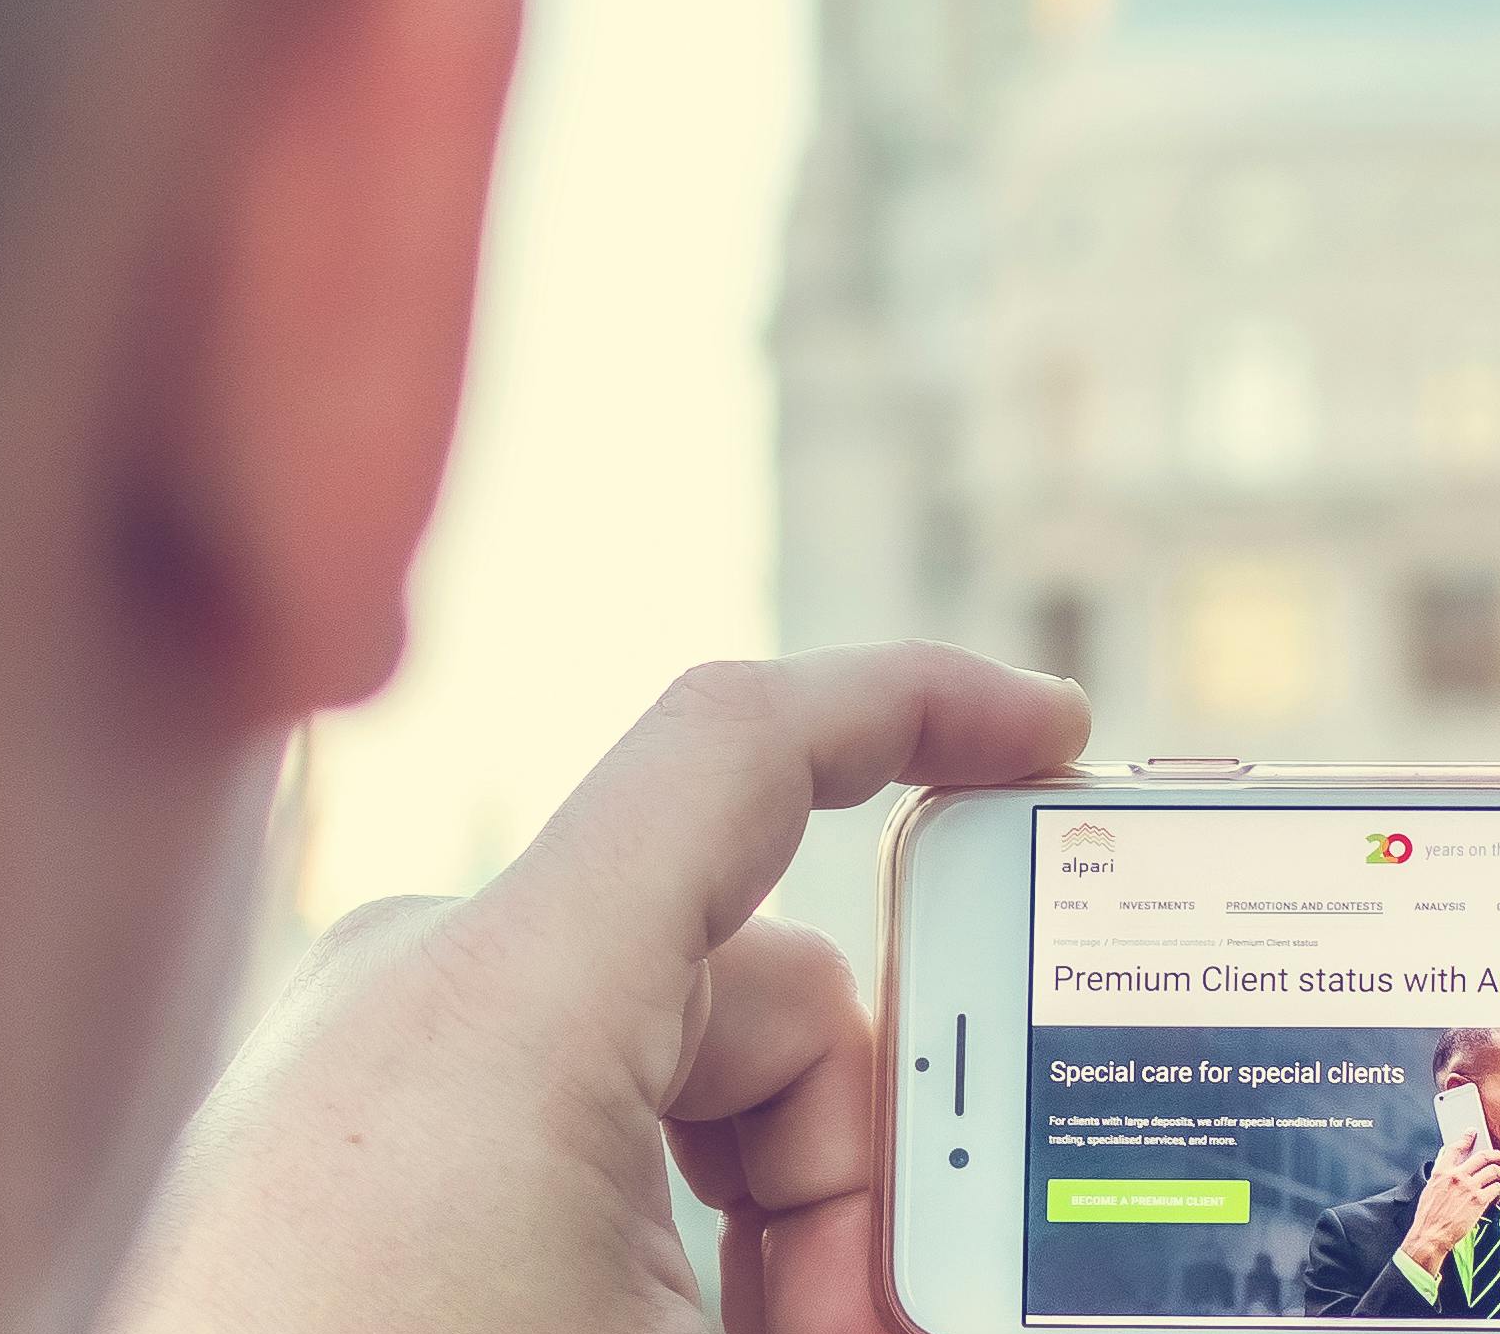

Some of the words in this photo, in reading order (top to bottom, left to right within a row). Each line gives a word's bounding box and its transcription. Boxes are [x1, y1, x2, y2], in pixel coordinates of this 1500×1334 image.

[1365, 833, 1413, 864] 20
[1425, 843, 1464, 860] years
[1468, 843, 1486, 857] on
[1061, 857, 1114, 877] alpari
[1054, 900, 1089, 910] FOREX
[1119, 901, 1196, 910] INVESTMENTS
[1226, 901, 1298, 911] PROMOTIONS
[1301, 901, 1323, 911] AND
[1327, 901, 1383, 911] CONTESTS
[1414, 902, 1466, 912] ANALYSIS
[1053, 938, 1078, 946] Home
[1080, 939, 1100, 948] page
[1227, 938, 1264, 946] Premium
[1266, 938, 1290, 946] Client
[1292, 939, 1318, 947] status
[1054, 966, 1190, 992] Premium
[1202, 966, 1288, 992] Client
[1298, 968, 1393, 993] status
[1404, 966, 1466, 993] with
[1050, 1060, 1135, 1086] Special
[1141, 1066, 1192, 1083] care
[1199, 1060, 1233, 1083] for
[1238, 1061, 1319, 1088] special
[1327, 1061, 1405, 1084] clients
[1049, 1116, 1066, 1126] For
[1067, 1116, 1100, 1126] clients
[1102, 1116, 1123, 1126] with
[1124, 1116, 1150, 1128] large
[1151, 1116, 1196, 1128] deposits,
[1197, 1118, 1212, 1126] we
[1215, 1117, 1238, 1127] offer
[1239, 1117, 1274, 1129] special
[1276, 1117, 1328, 1127] conditions
[1329, 1117, 1344, 1127] for
[1345, 1117, 1373, 1128] Forex
[1049, 1134, 1085, 1146] trading,
[1087, 1135, 1143, 1146] specialised
[1143, 1135, 1187, 1146] services,
[1188, 1135, 1208, 1145] and
[1209, 1136, 1238, 1146] more.
[1071, 1195, 1117, 1206] BECOME
[1120, 1196, 1128, 1206] A
[1131, 1195, 1184, 1206] PREMIUM
[1187, 1196, 1225, 1207] CLIENT
